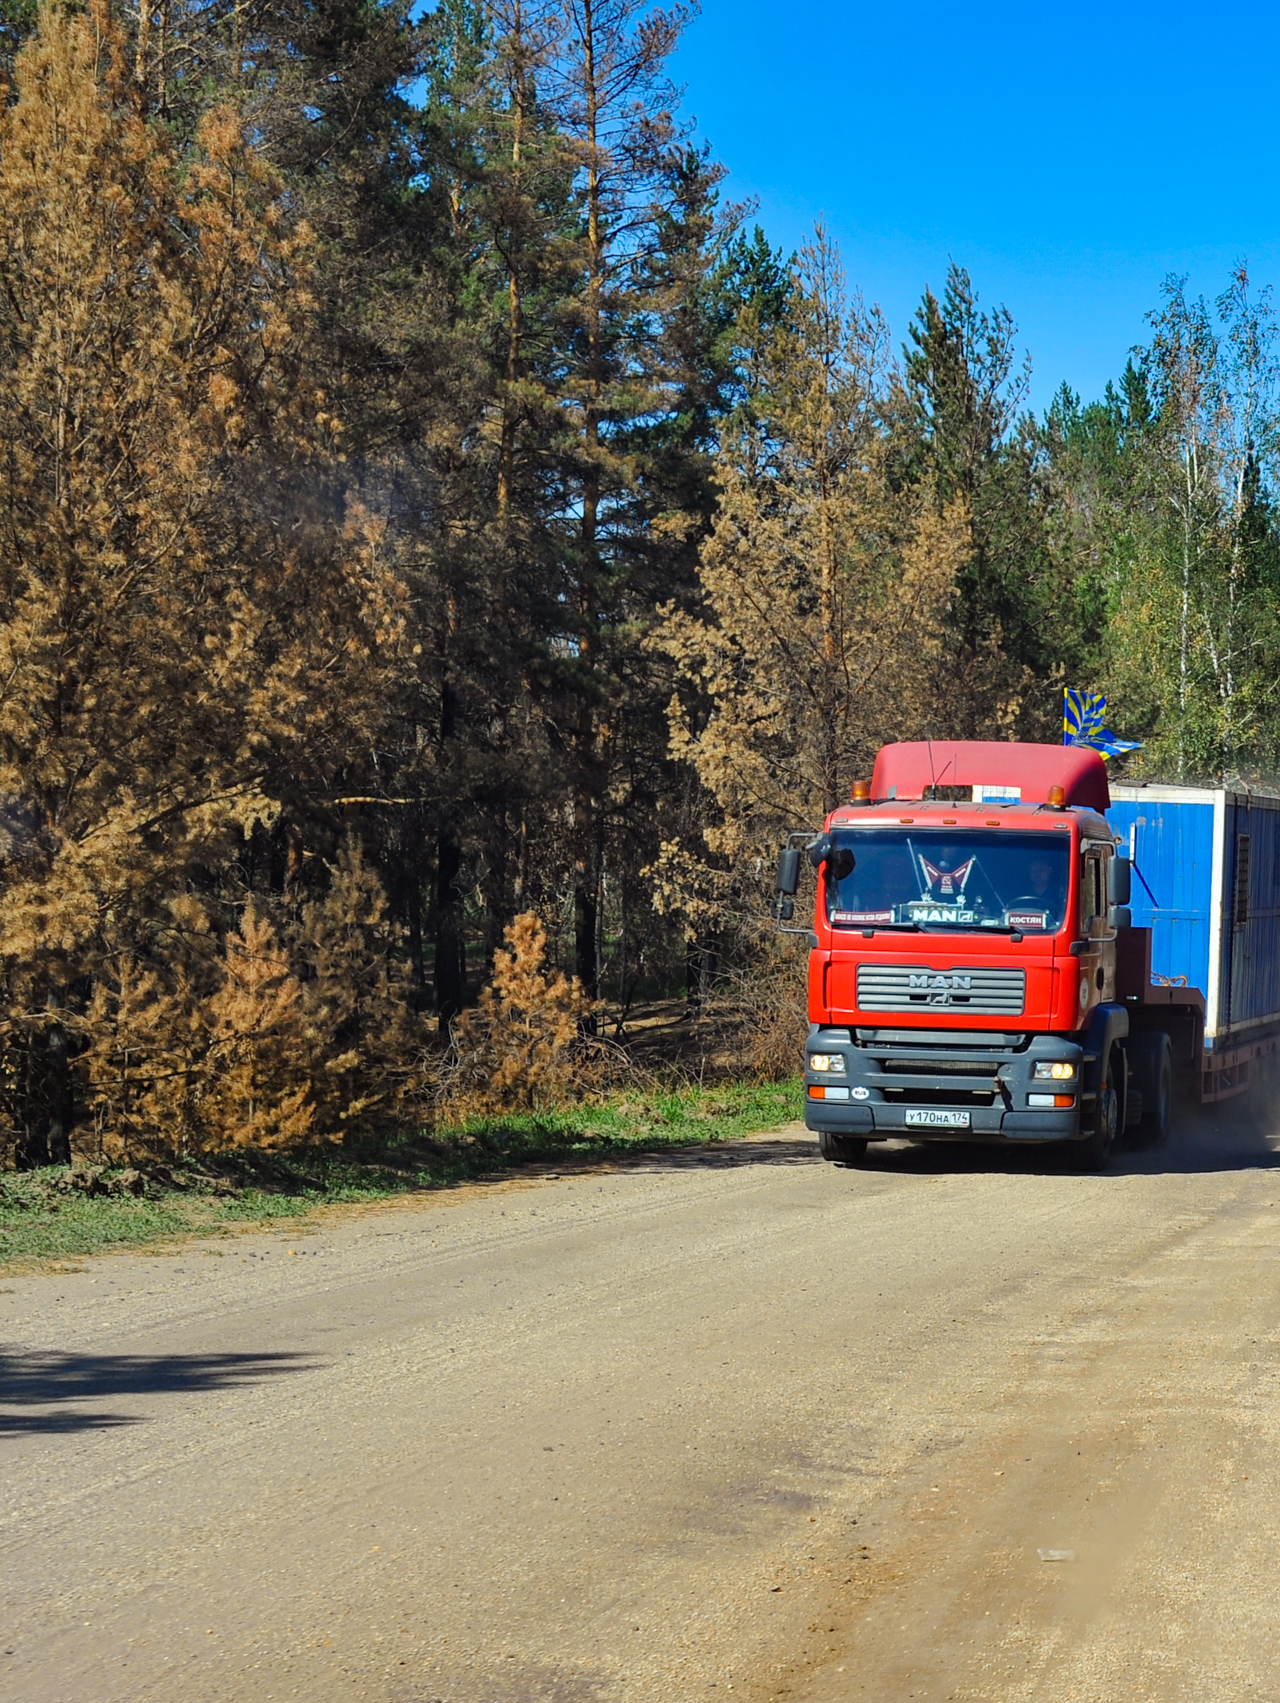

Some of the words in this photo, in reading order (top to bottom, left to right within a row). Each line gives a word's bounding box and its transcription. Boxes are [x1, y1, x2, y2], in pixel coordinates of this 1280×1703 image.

[913, 909, 957, 921] MAN
[1009, 916, 1042, 924] КОСТЯН
[909, 974, 971, 990] MAN
[952, 1112, 968, 1122] 174
